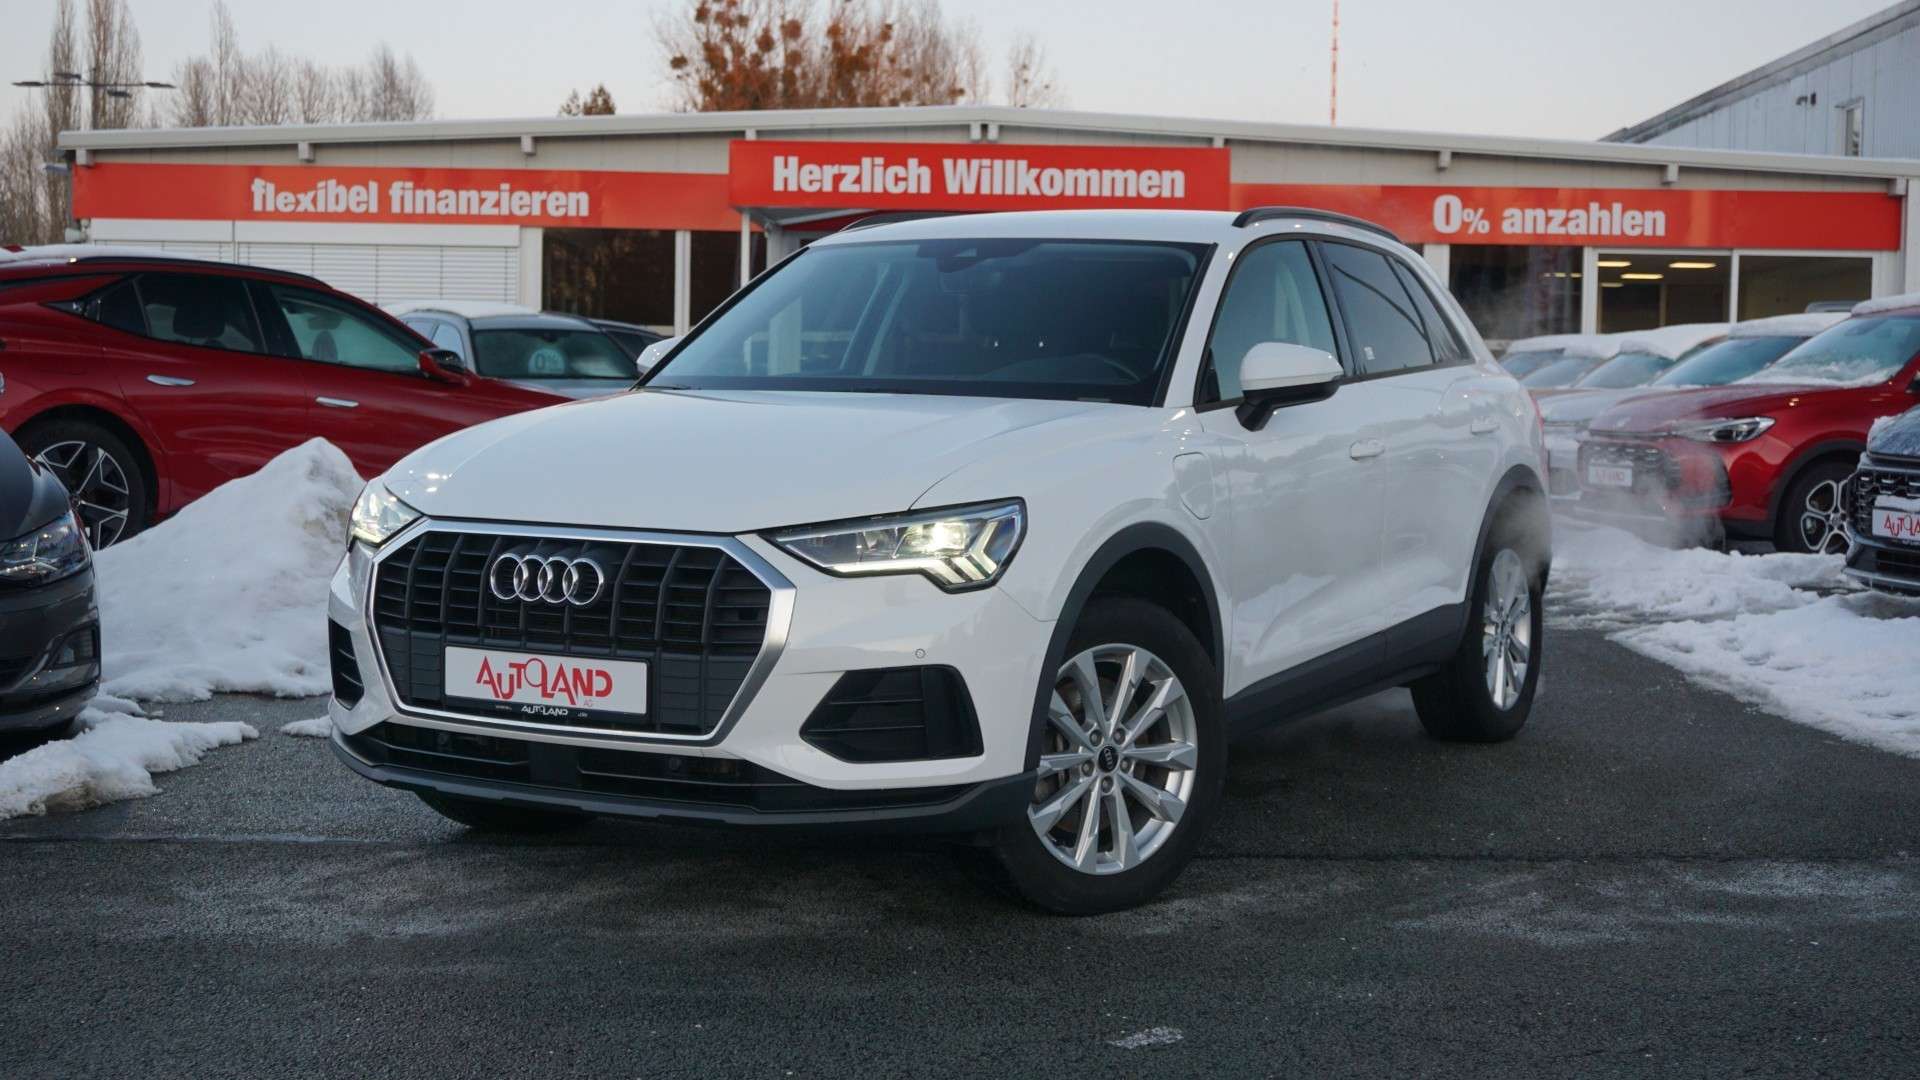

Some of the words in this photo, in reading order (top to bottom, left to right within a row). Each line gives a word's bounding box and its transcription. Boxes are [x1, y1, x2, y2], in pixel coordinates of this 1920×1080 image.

[251, 178, 378, 213] flexibel
[389, 181, 590, 217] finanzieren
[773, 156, 932, 193] Herzlich
[943, 158, 1186, 198] Willkommen
[1433, 194, 1490, 234] 0%
[1501, 201, 1666, 236] anzahlen
[476, 656, 613, 705] AUTOLAND
